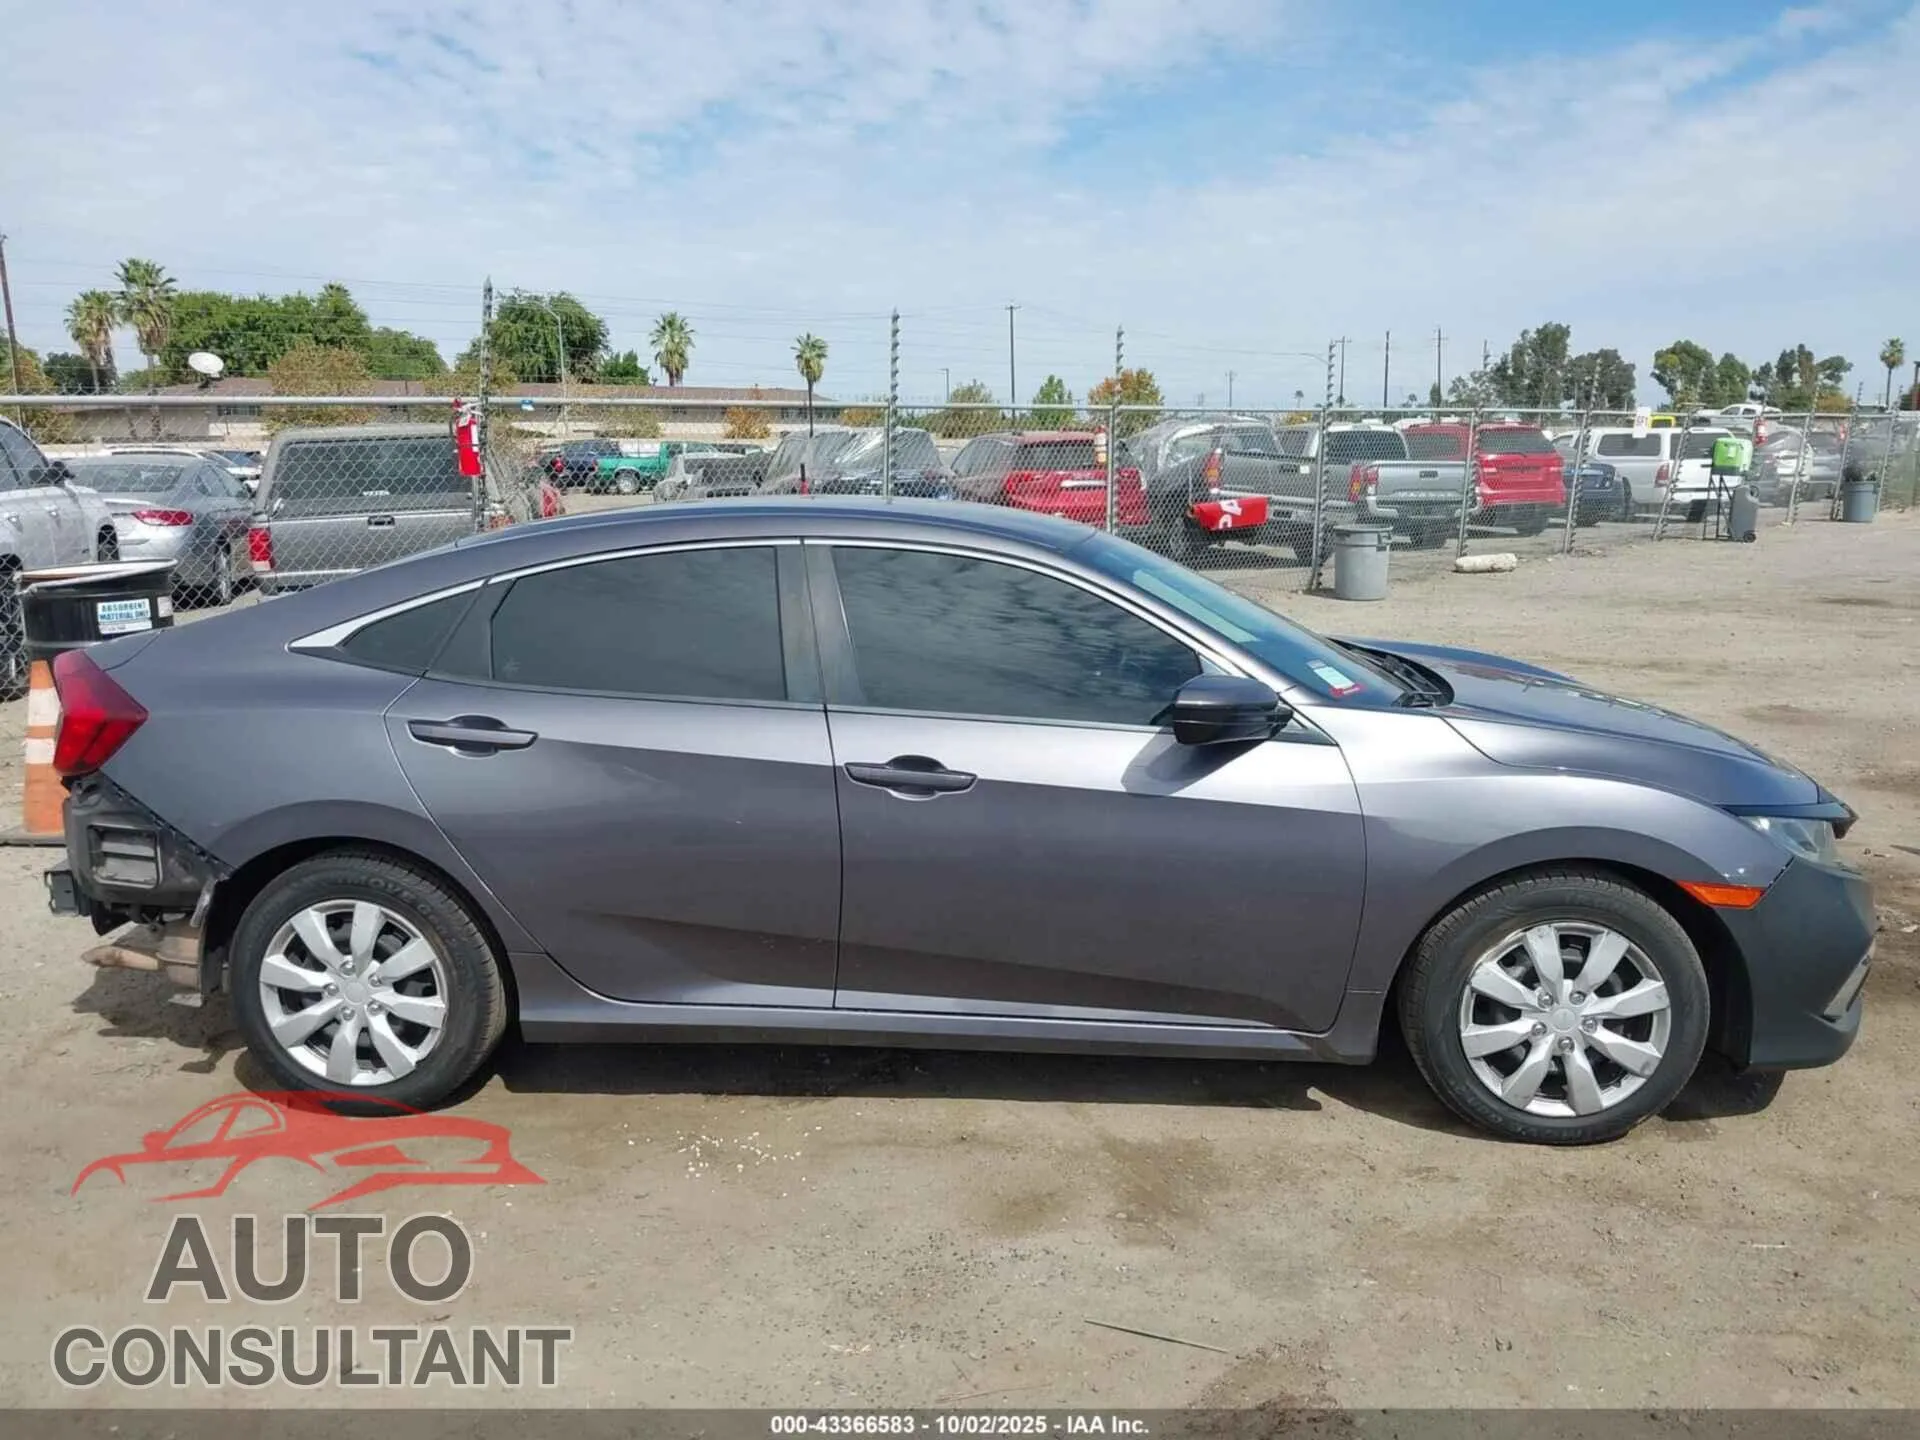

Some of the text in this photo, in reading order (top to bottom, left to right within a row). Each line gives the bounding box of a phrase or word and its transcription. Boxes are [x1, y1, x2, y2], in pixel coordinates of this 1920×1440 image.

[101, 601, 146, 612] ABSORBENT
[100, 610, 149, 621] MATERIAL ONLY
